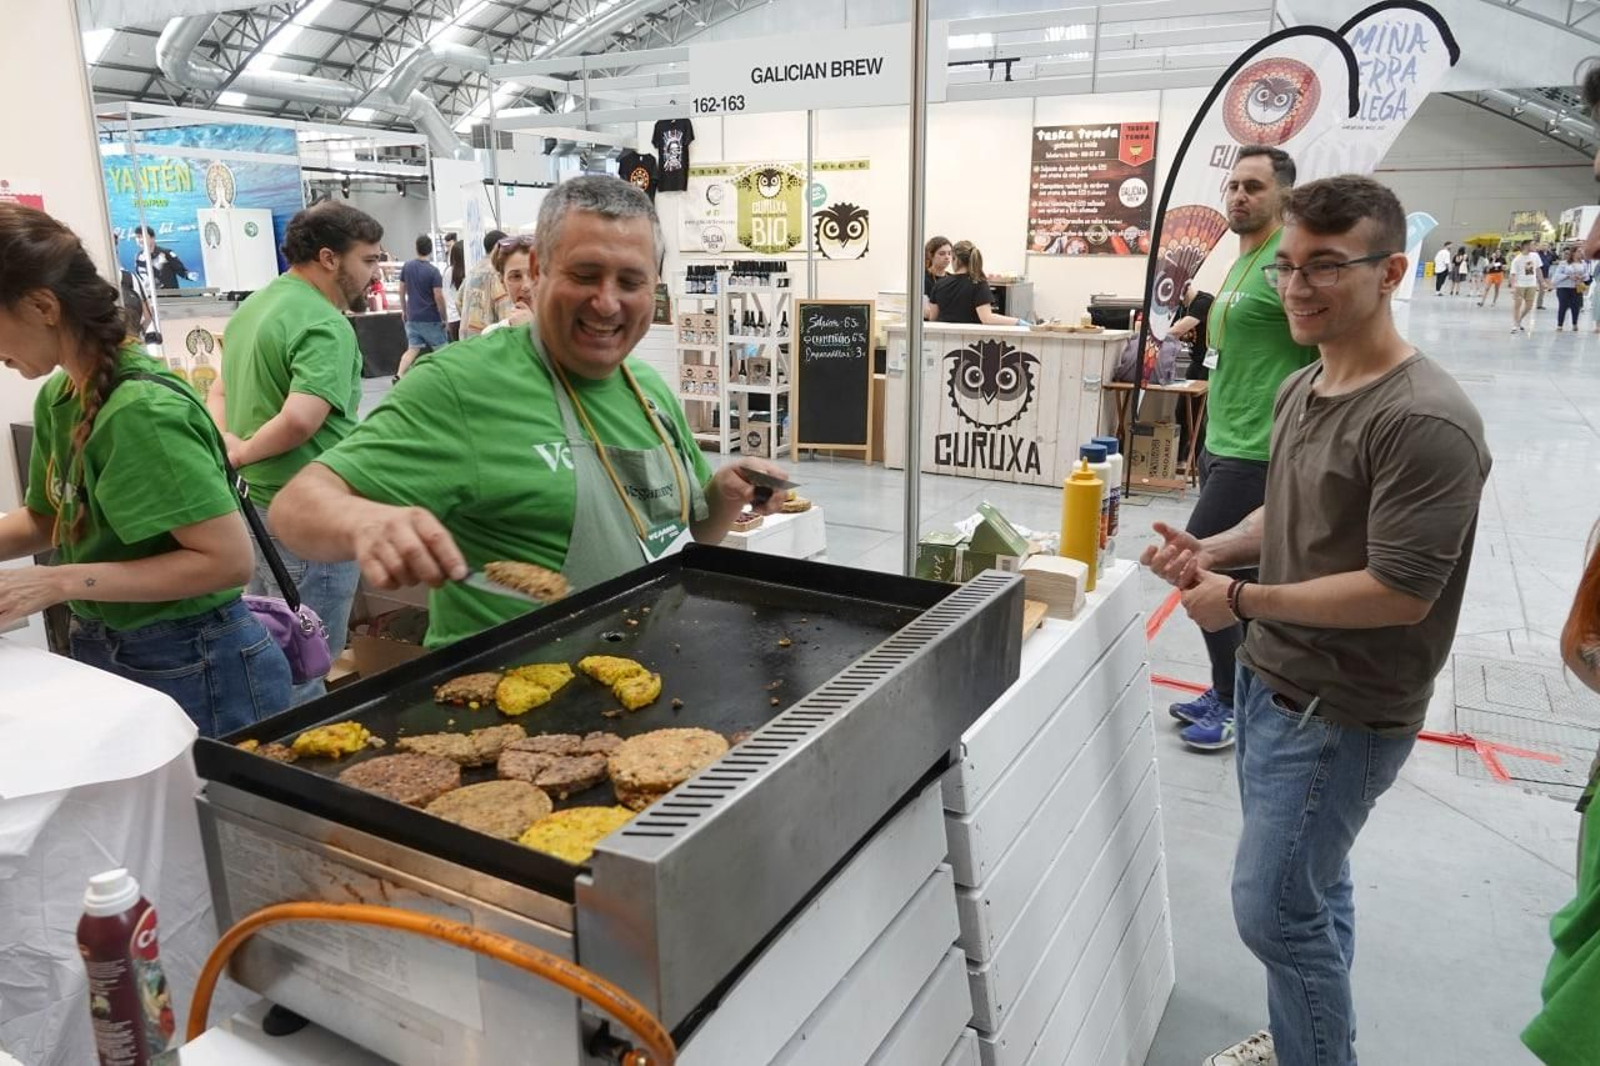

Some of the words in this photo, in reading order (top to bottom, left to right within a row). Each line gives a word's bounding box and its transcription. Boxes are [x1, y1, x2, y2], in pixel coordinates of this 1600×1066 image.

[1352, 21, 1430, 54] MIÑA
[751, 61, 827, 85] GALICIAN
[830, 57, 884, 78] BREW
[1359, 55, 1417, 93] ERRA
[692, 94, 745, 113] 162-163
[1360, 88, 1408, 121] LEGA
[752, 216, 788, 246] BIO
[533, 442, 575, 472] Ve
[935, 432, 1041, 475] CURUXA
[1162, 439, 1171, 478] ONDARIZ
